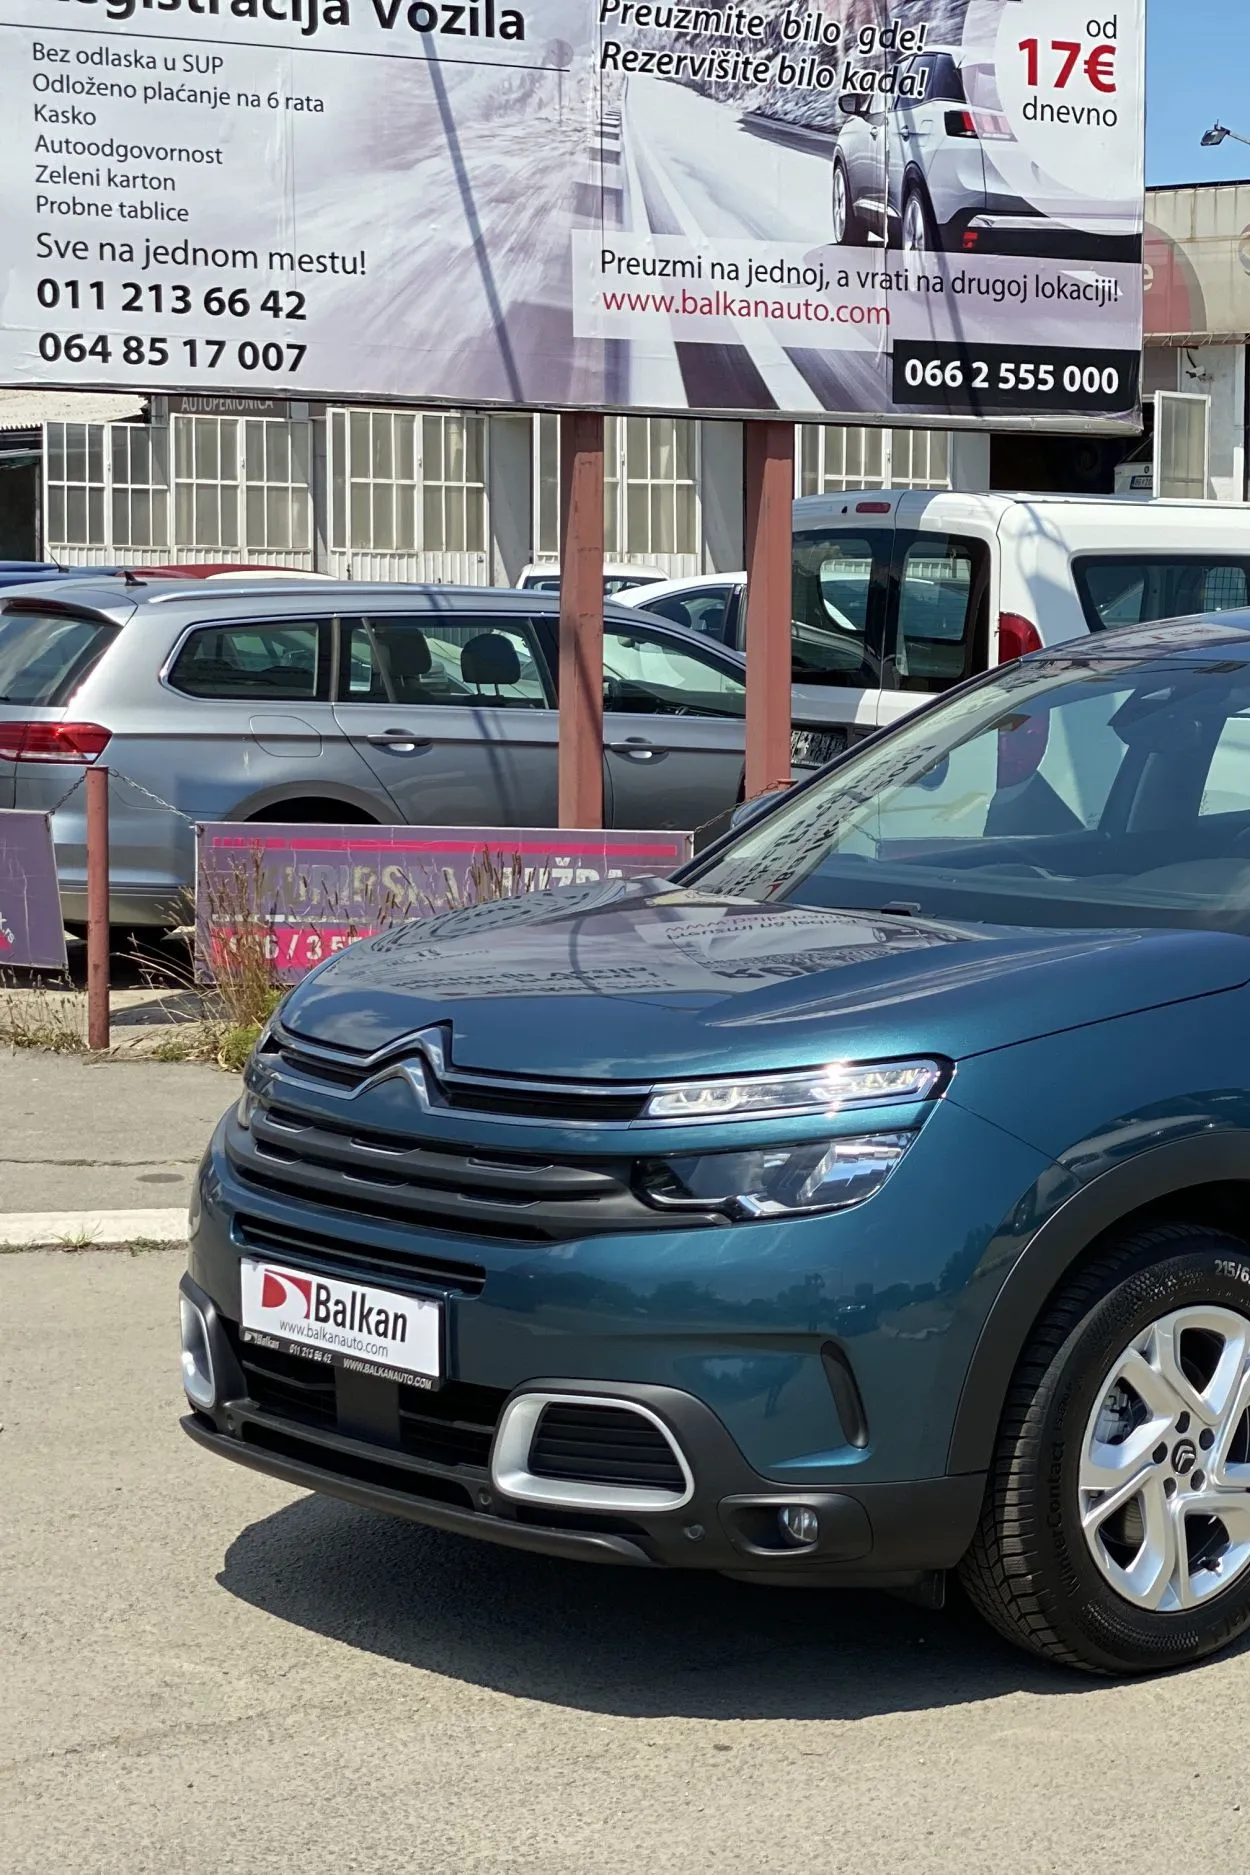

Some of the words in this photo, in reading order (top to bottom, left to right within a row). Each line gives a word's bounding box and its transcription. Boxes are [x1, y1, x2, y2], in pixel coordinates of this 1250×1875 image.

[375, 0, 526, 41] Vozila
[599, 0, 764, 36] Preuzmite
[783, 11, 841, 44] bilo
[859, 21, 927, 53] gde!
[1086, 15, 1117, 39] od
[32, 43, 71, 64] Bez
[76, 46, 157, 71] odlaska
[163, 56, 177, 71] u
[182, 53, 224, 75] SUP
[600, 41, 770, 83] Rezervišite
[779, 55, 834, 87] bilo
[842, 63, 928, 96] kada!
[1018, 38, 1117, 93] 17€
[32, 73, 138, 99] Odloženo
[143, 81, 231, 109] plaćanje
[236, 92, 262, 109] na
[267, 91, 279, 110] 6
[285, 93, 325, 113] rata
[1023, 96, 1118, 127] dnevno
[34, 104, 97, 127] Kasko
[35, 134, 223, 165] Autoodgovornost
[36, 165, 100, 187] Zeleni
[107, 169, 176, 192] karton
[36, 196, 113, 218] Probne
[119, 201, 190, 223] tablice
[36, 233, 89, 260] Sve
[99, 240, 133, 263] na
[142, 238, 258, 271] jednom
[268, 248, 367, 276] mestu!
[601, 250, 701, 280] Preuzmi
[710, 261, 739, 281] na
[746, 257, 831, 291] jednoj,
[837, 271, 849, 287] a
[857, 267, 909, 291] vrati
[917, 272, 944, 293] na
[952, 271, 1028, 303] drugoj
[1035, 274, 1119, 307] lokaciji!
[36, 278, 105, 311] 011
[121, 281, 192, 315] 213
[203, 286, 250, 318] 66
[260, 289, 308, 321] 42
[603, 288, 891, 325] www.balkanauto.com
[38, 332, 112, 365] 064
[122, 336, 169, 367] 85
[182, 339, 226, 370] 17
[237, 341, 308, 373] 007
[905, 358, 963, 387] 066
[971, 361, 989, 388] 2
[998, 362, 1055, 391] 555
[1062, 366, 1119, 393] 000
[314, 1282, 407, 1343] Balkan
[279, 1319, 388, 1358] www.balkanauto.com
[343, 1358, 432, 1389] WWW.BALKANAUTO.COM
